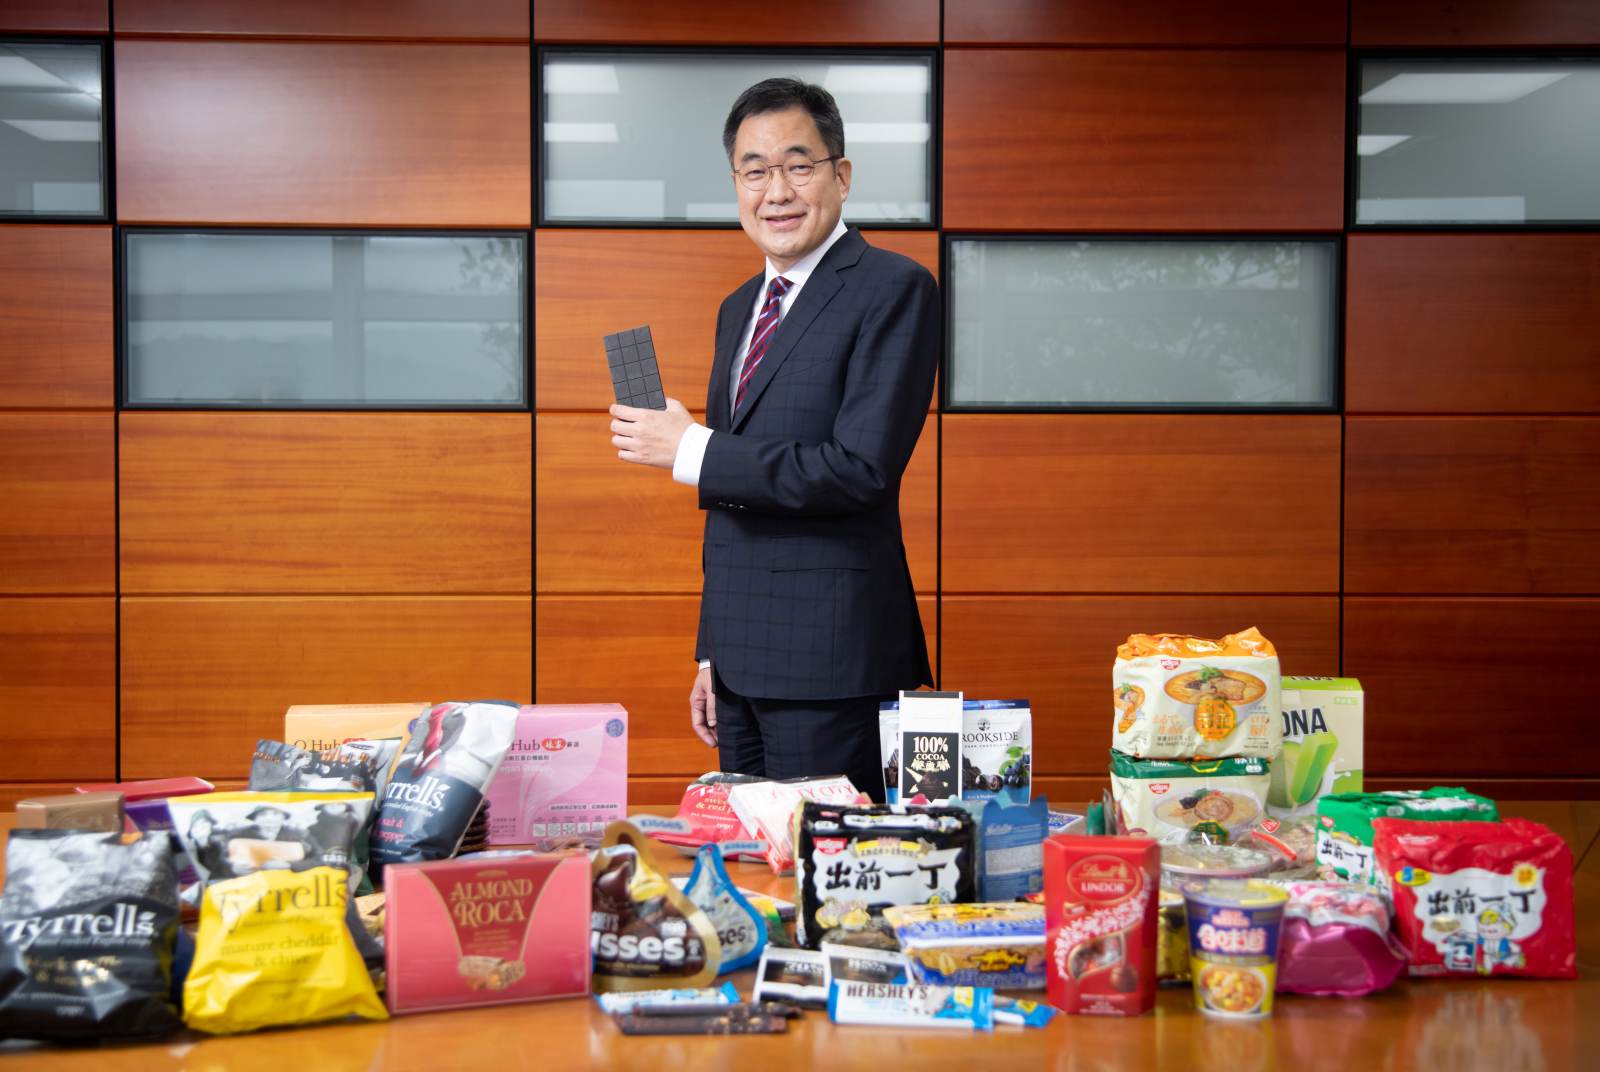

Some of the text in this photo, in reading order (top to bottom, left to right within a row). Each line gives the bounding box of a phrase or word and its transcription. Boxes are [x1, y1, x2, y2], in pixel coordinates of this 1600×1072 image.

[1281, 707, 1328, 736] ONA
[511, 739, 541, 751] Hub
[913, 736, 949, 753] 100%
[962, 731, 1019, 744] ROOKSIDE
[916, 753, 946, 761] COCOA
[387, 776, 450, 811] rrells
[1321, 839, 1367, 869] 出前一丁
[825, 860, 947, 890] 出前一丁
[449, 878, 533, 901] ALMOND
[1081, 881, 1125, 893] LINDOR
[1427, 887, 1536, 915] 出前一丁
[454, 899, 528, 928] ROCA
[2, 902, 157, 951] Tyrrells
[716, 926, 746, 947] ses
[279, 933, 341, 948] cheddar
[592, 931, 686, 962] isses
[847, 983, 928, 1000] HERSHEY'S
